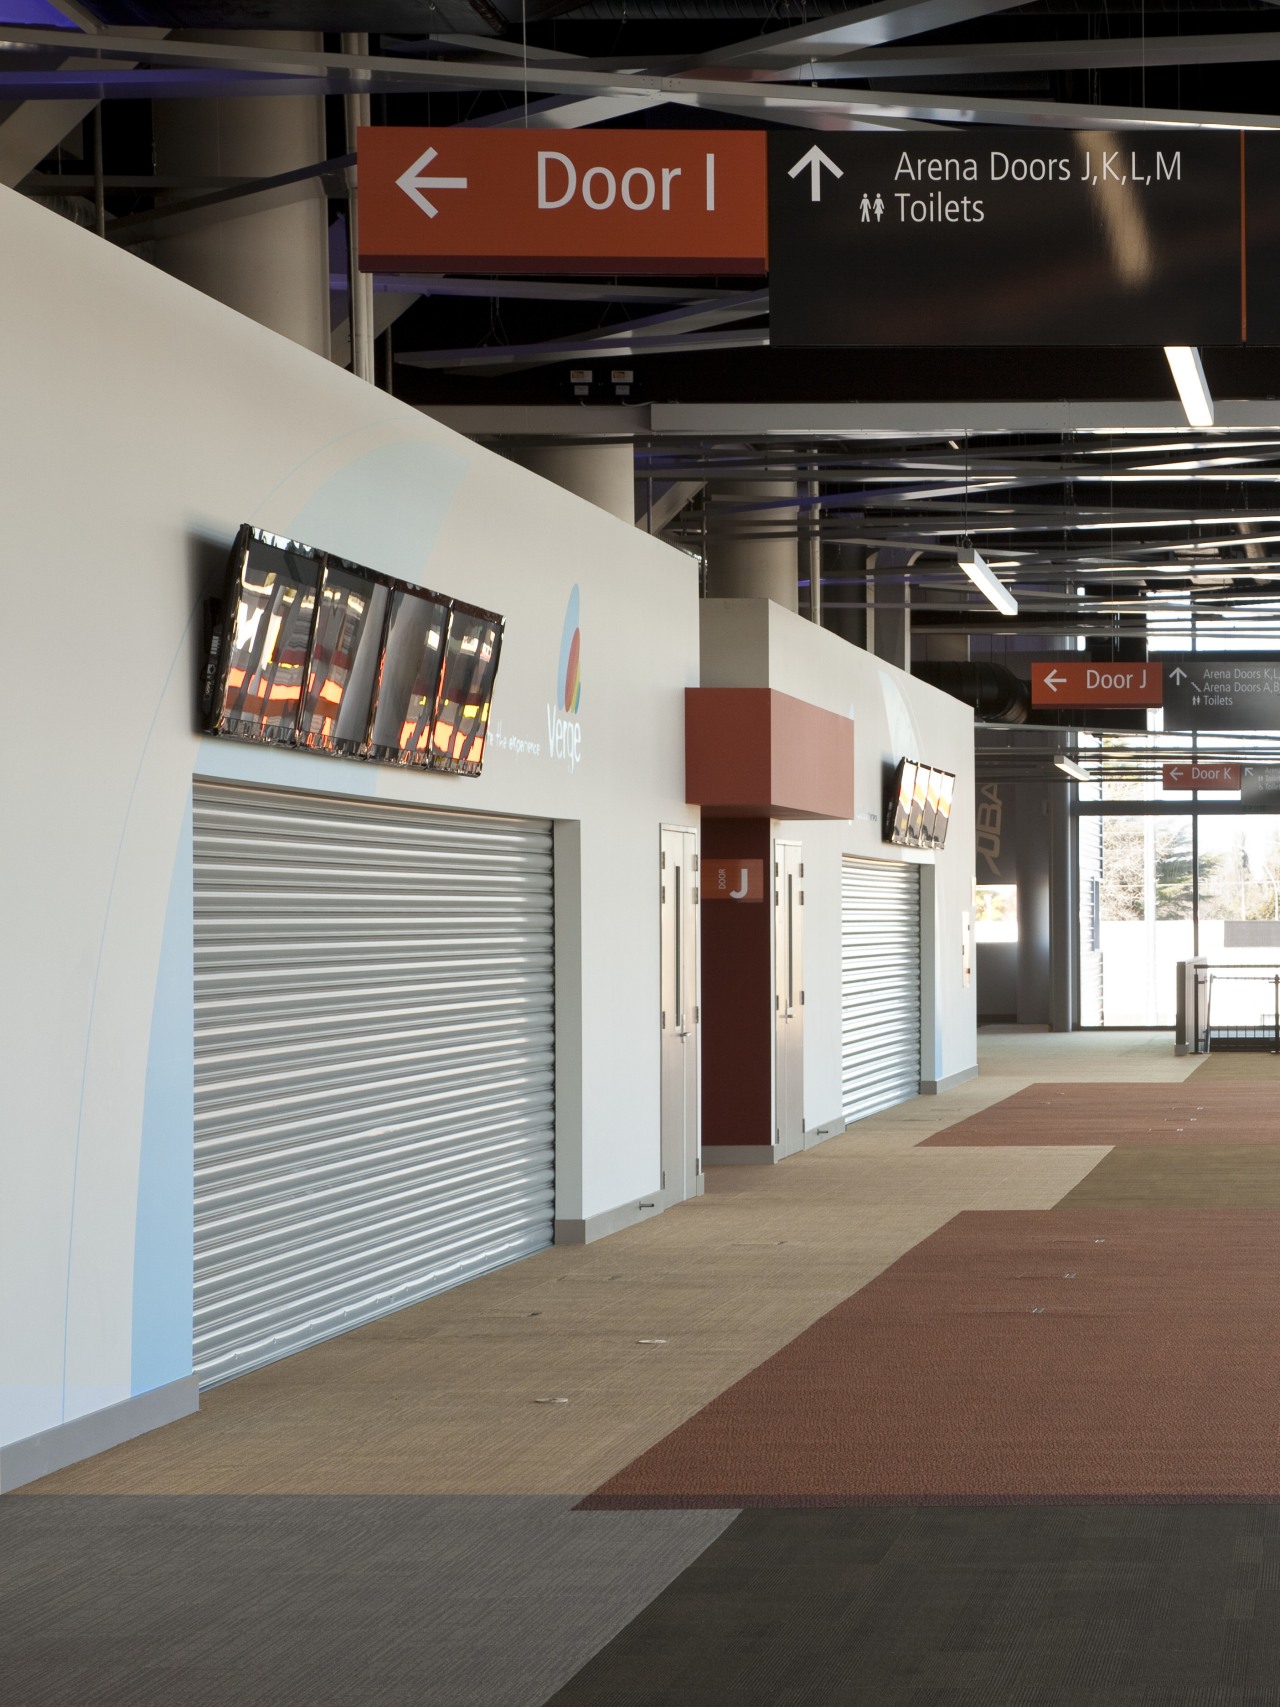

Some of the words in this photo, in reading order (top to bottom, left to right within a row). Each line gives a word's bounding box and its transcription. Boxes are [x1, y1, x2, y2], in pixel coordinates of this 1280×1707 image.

[537, 150, 682, 211] Door
[706, 153, 715, 211] I
[894, 151, 978, 181] Arena
[991, 151, 1071, 181] Doors
[1080, 151, 1182, 186] J,K,L,M
[894, 191, 985, 222] Toilets
[1086, 669, 1133, 689] Door
[1139, 669, 1147, 689] J
[1203, 668, 1231, 679] Arena
[1234, 668, 1261, 679] Doors
[1203, 681, 1231, 692] Arena
[1234, 681, 1261, 692] Doors
[1203, 695, 1233, 706] Toilets
[547, 703, 582, 775] Verge
[1191, 767, 1220, 780] Door
[1224, 767, 1231, 780] K
[718, 868, 727, 890] DOOR
[729, 868, 748, 899] J
